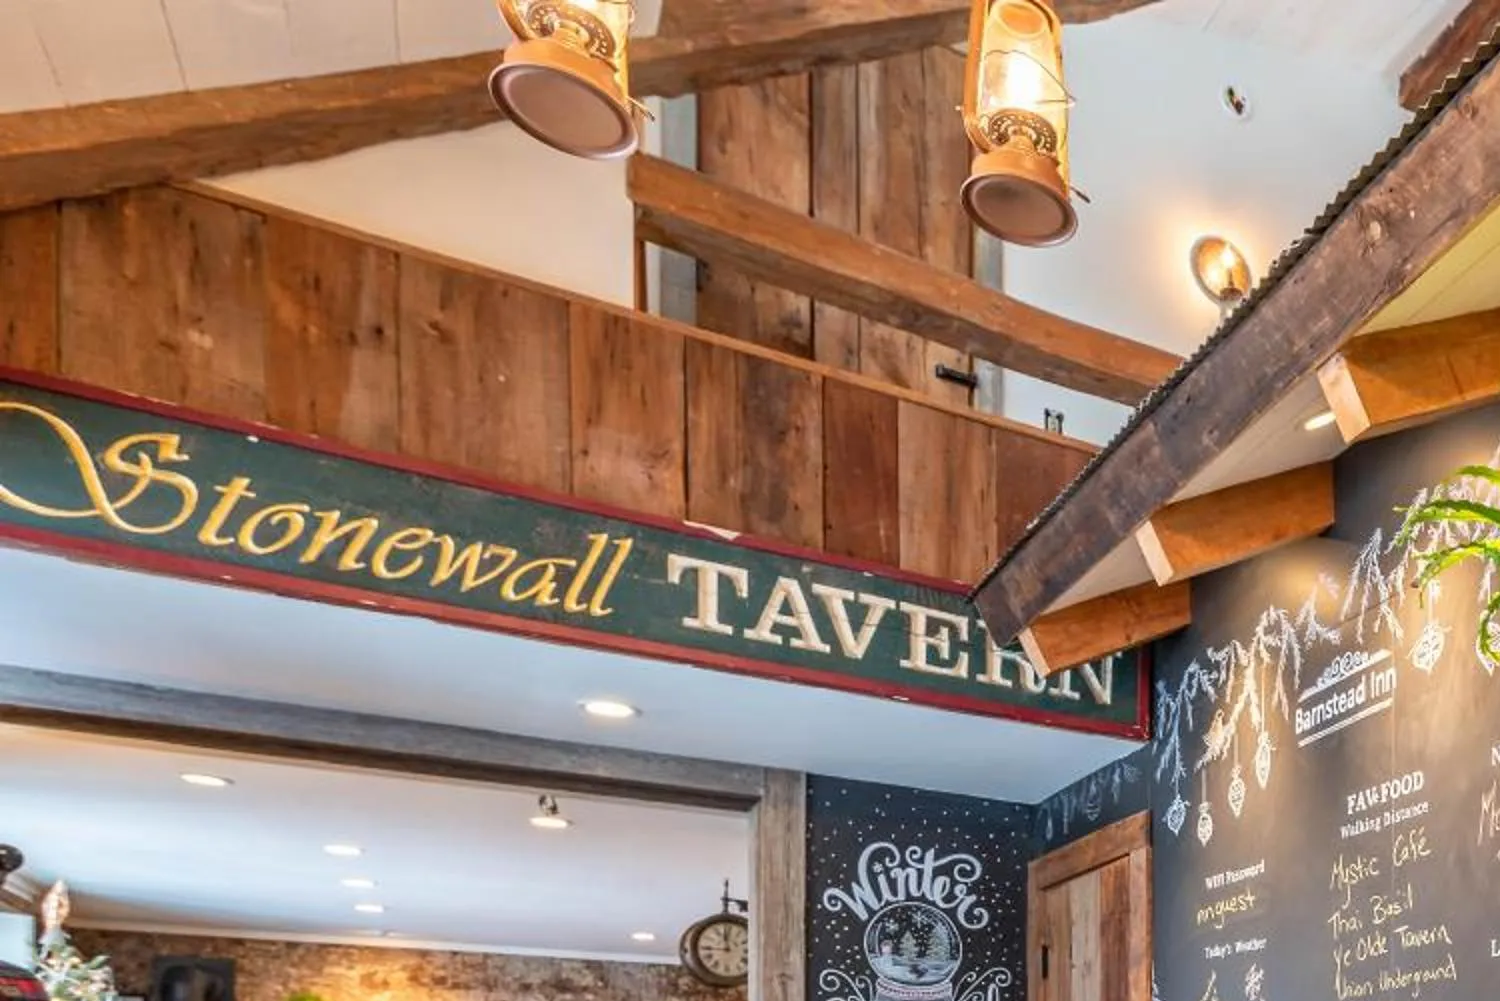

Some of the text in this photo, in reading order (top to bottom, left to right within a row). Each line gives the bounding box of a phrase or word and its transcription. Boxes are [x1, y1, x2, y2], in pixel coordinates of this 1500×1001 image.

[0, 402, 636, 617] Stonewall
[1294, 666, 1397, 735] Barnstead Inn
[1339, 801, 1429, 840] Walking Distance
[823, 841, 989, 929] Winter
[1329, 853, 1380, 910] Mystic
[1327, 882, 1414, 940] Thai Basil
[1355, 931, 1389, 961] Olde
[1393, 924, 1453, 948] Tavern
